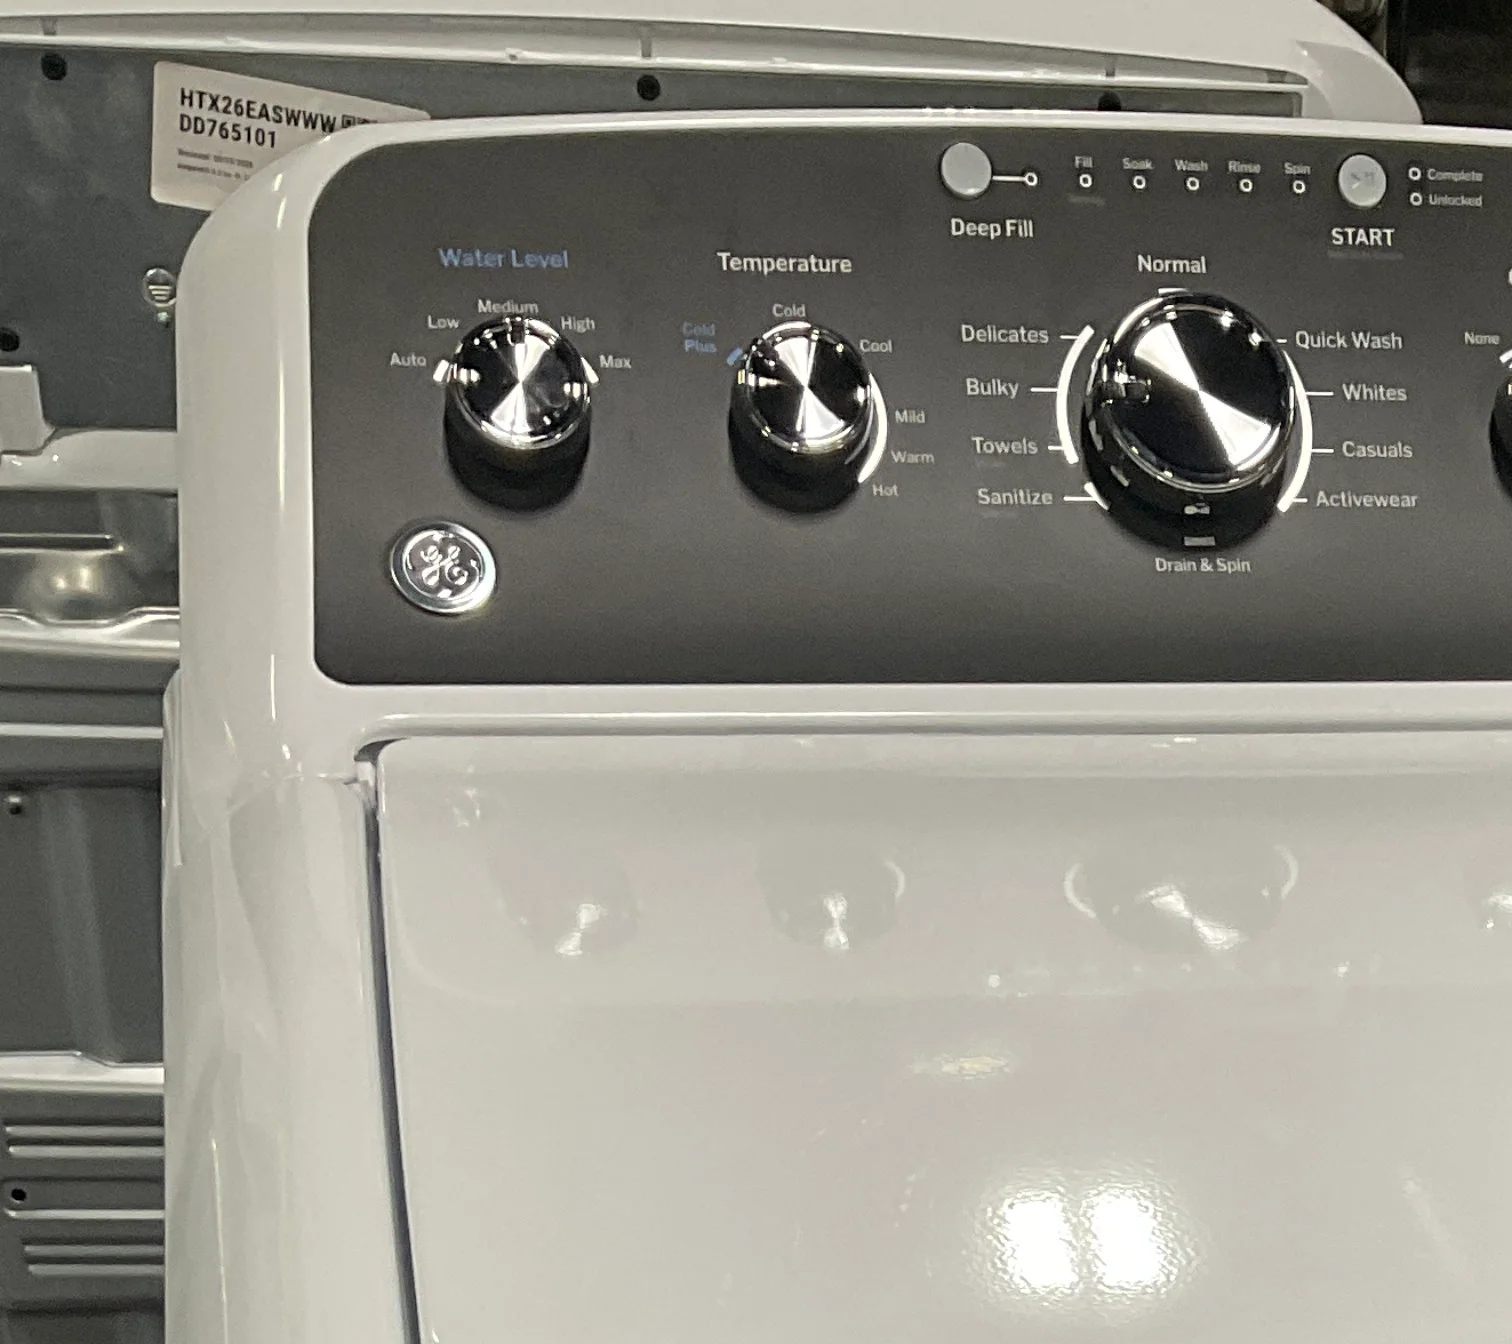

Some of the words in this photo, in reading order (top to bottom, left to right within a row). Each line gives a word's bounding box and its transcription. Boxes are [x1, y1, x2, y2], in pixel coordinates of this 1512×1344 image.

[179, 86, 337, 134] HTX26EASWWW
[179, 113, 276, 148] DD765101
[1074, 156, 1093, 169] Fill
[1174, 159, 1208, 172] Wash
[1228, 160, 1261, 174] Rinse
[1284, 162, 1311, 176] Spin
[1427, 168, 1484, 183] Complete
[951, 217, 1001, 240] Deep
[1005, 218, 1034, 238] Fill
[1331, 227, 1395, 247] START
[438, 248, 504, 268] Water
[510, 249, 569, 268] Level
[717, 252, 853, 276] Temperature
[1137, 254, 1208, 274] Normal
[477, 299, 539, 314] Medium
[772, 303, 806, 318] Cold
[427, 315, 461, 330] Low
[560, 315, 596, 334] High
[682, 321, 716, 336] Cold
[961, 324, 1050, 344] Delicates
[1295, 330, 1348, 350] Quick
[1350, 330, 1403, 350] Wash
[1464, 331, 1501, 345] None
[684, 339, 717, 354] Plus
[859, 338, 893, 353] Cool
[390, 352, 427, 367] Auto
[600, 354, 632, 369] Max
[966, 377, 1019, 399] Bulky
[1342, 382, 1408, 401] Whites
[895, 408, 926, 424] Mild
[971, 436, 1038, 455] Towels
[1342, 440, 1413, 459] Casuals
[890, 449, 935, 464] Warm
[872, 483, 899, 498] Hot
[977, 488, 1053, 506] Sanitize
[1315, 490, 1418, 508] Activewear
[1154, 557, 1197, 573] Drain
[1199, 557, 1214, 573] &
[1216, 557, 1252, 575] Spin
